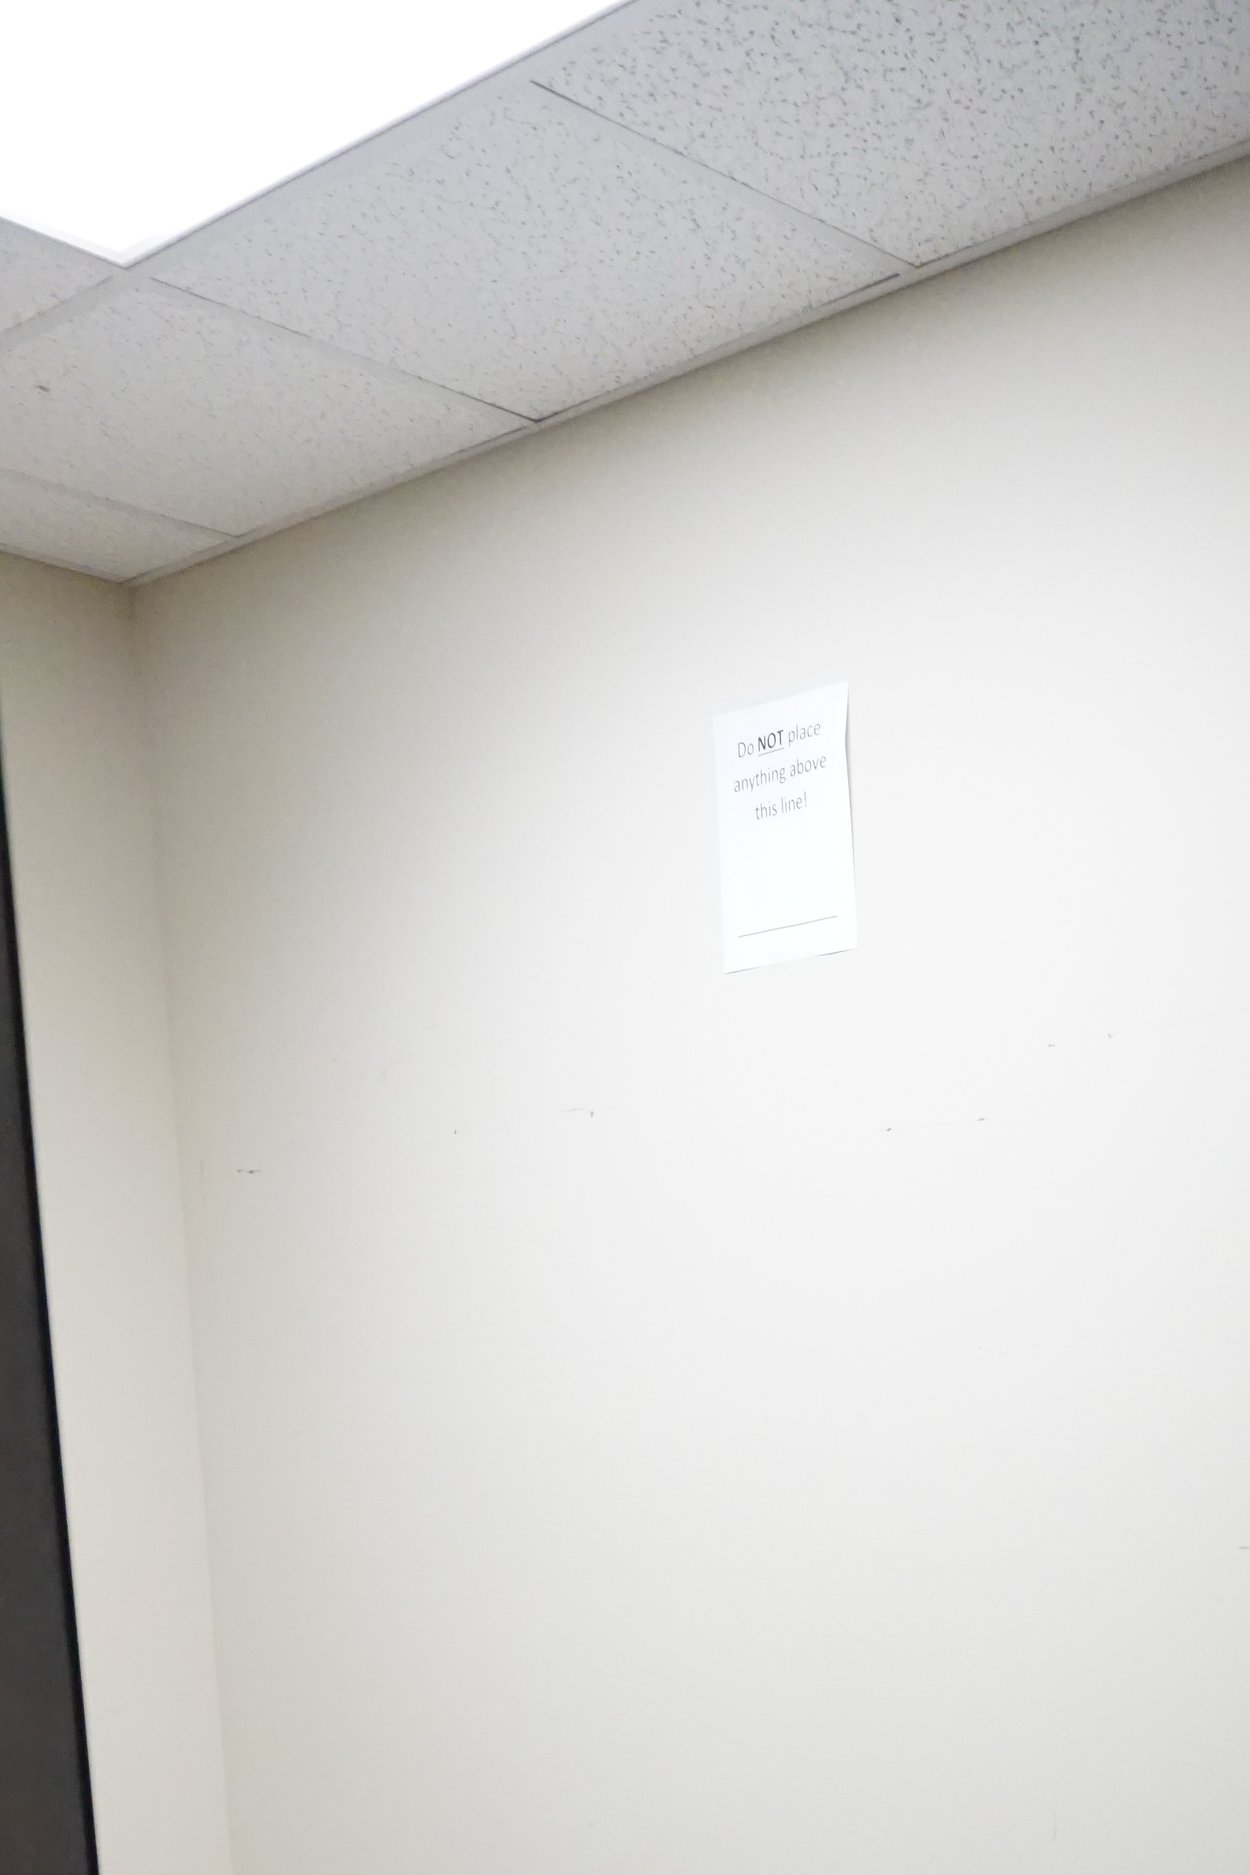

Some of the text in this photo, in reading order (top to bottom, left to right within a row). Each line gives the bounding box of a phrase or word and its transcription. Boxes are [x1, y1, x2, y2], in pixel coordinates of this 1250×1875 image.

[737, 723, 821, 759] Do NOT place
[733, 755, 827, 793] anything above
[755, 791, 808, 820] this line!
